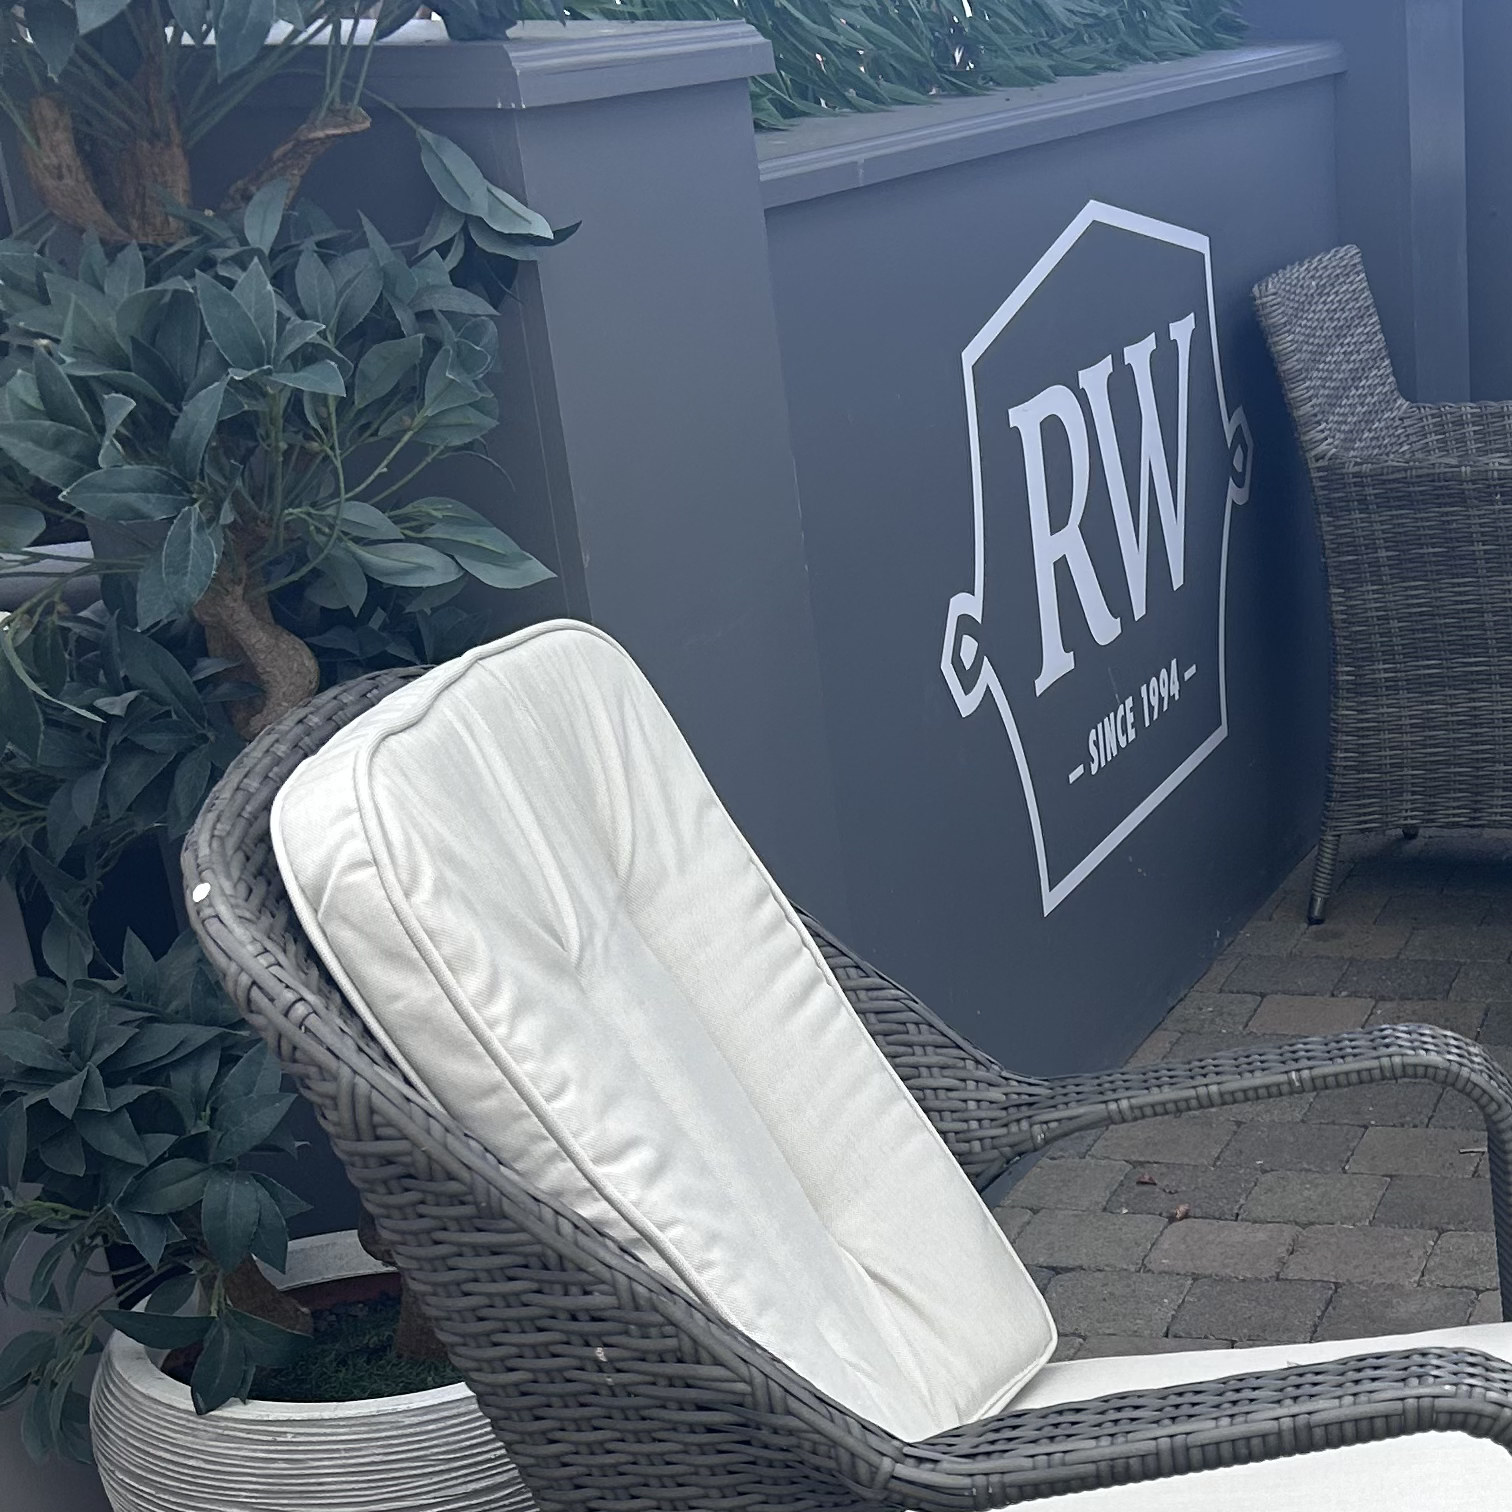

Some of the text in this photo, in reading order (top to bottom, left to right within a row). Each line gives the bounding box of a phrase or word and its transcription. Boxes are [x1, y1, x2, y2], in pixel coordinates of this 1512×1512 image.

[1008, 311, 1196, 697] RW
[1088, 658, 1180, 775] SINCE 1994
